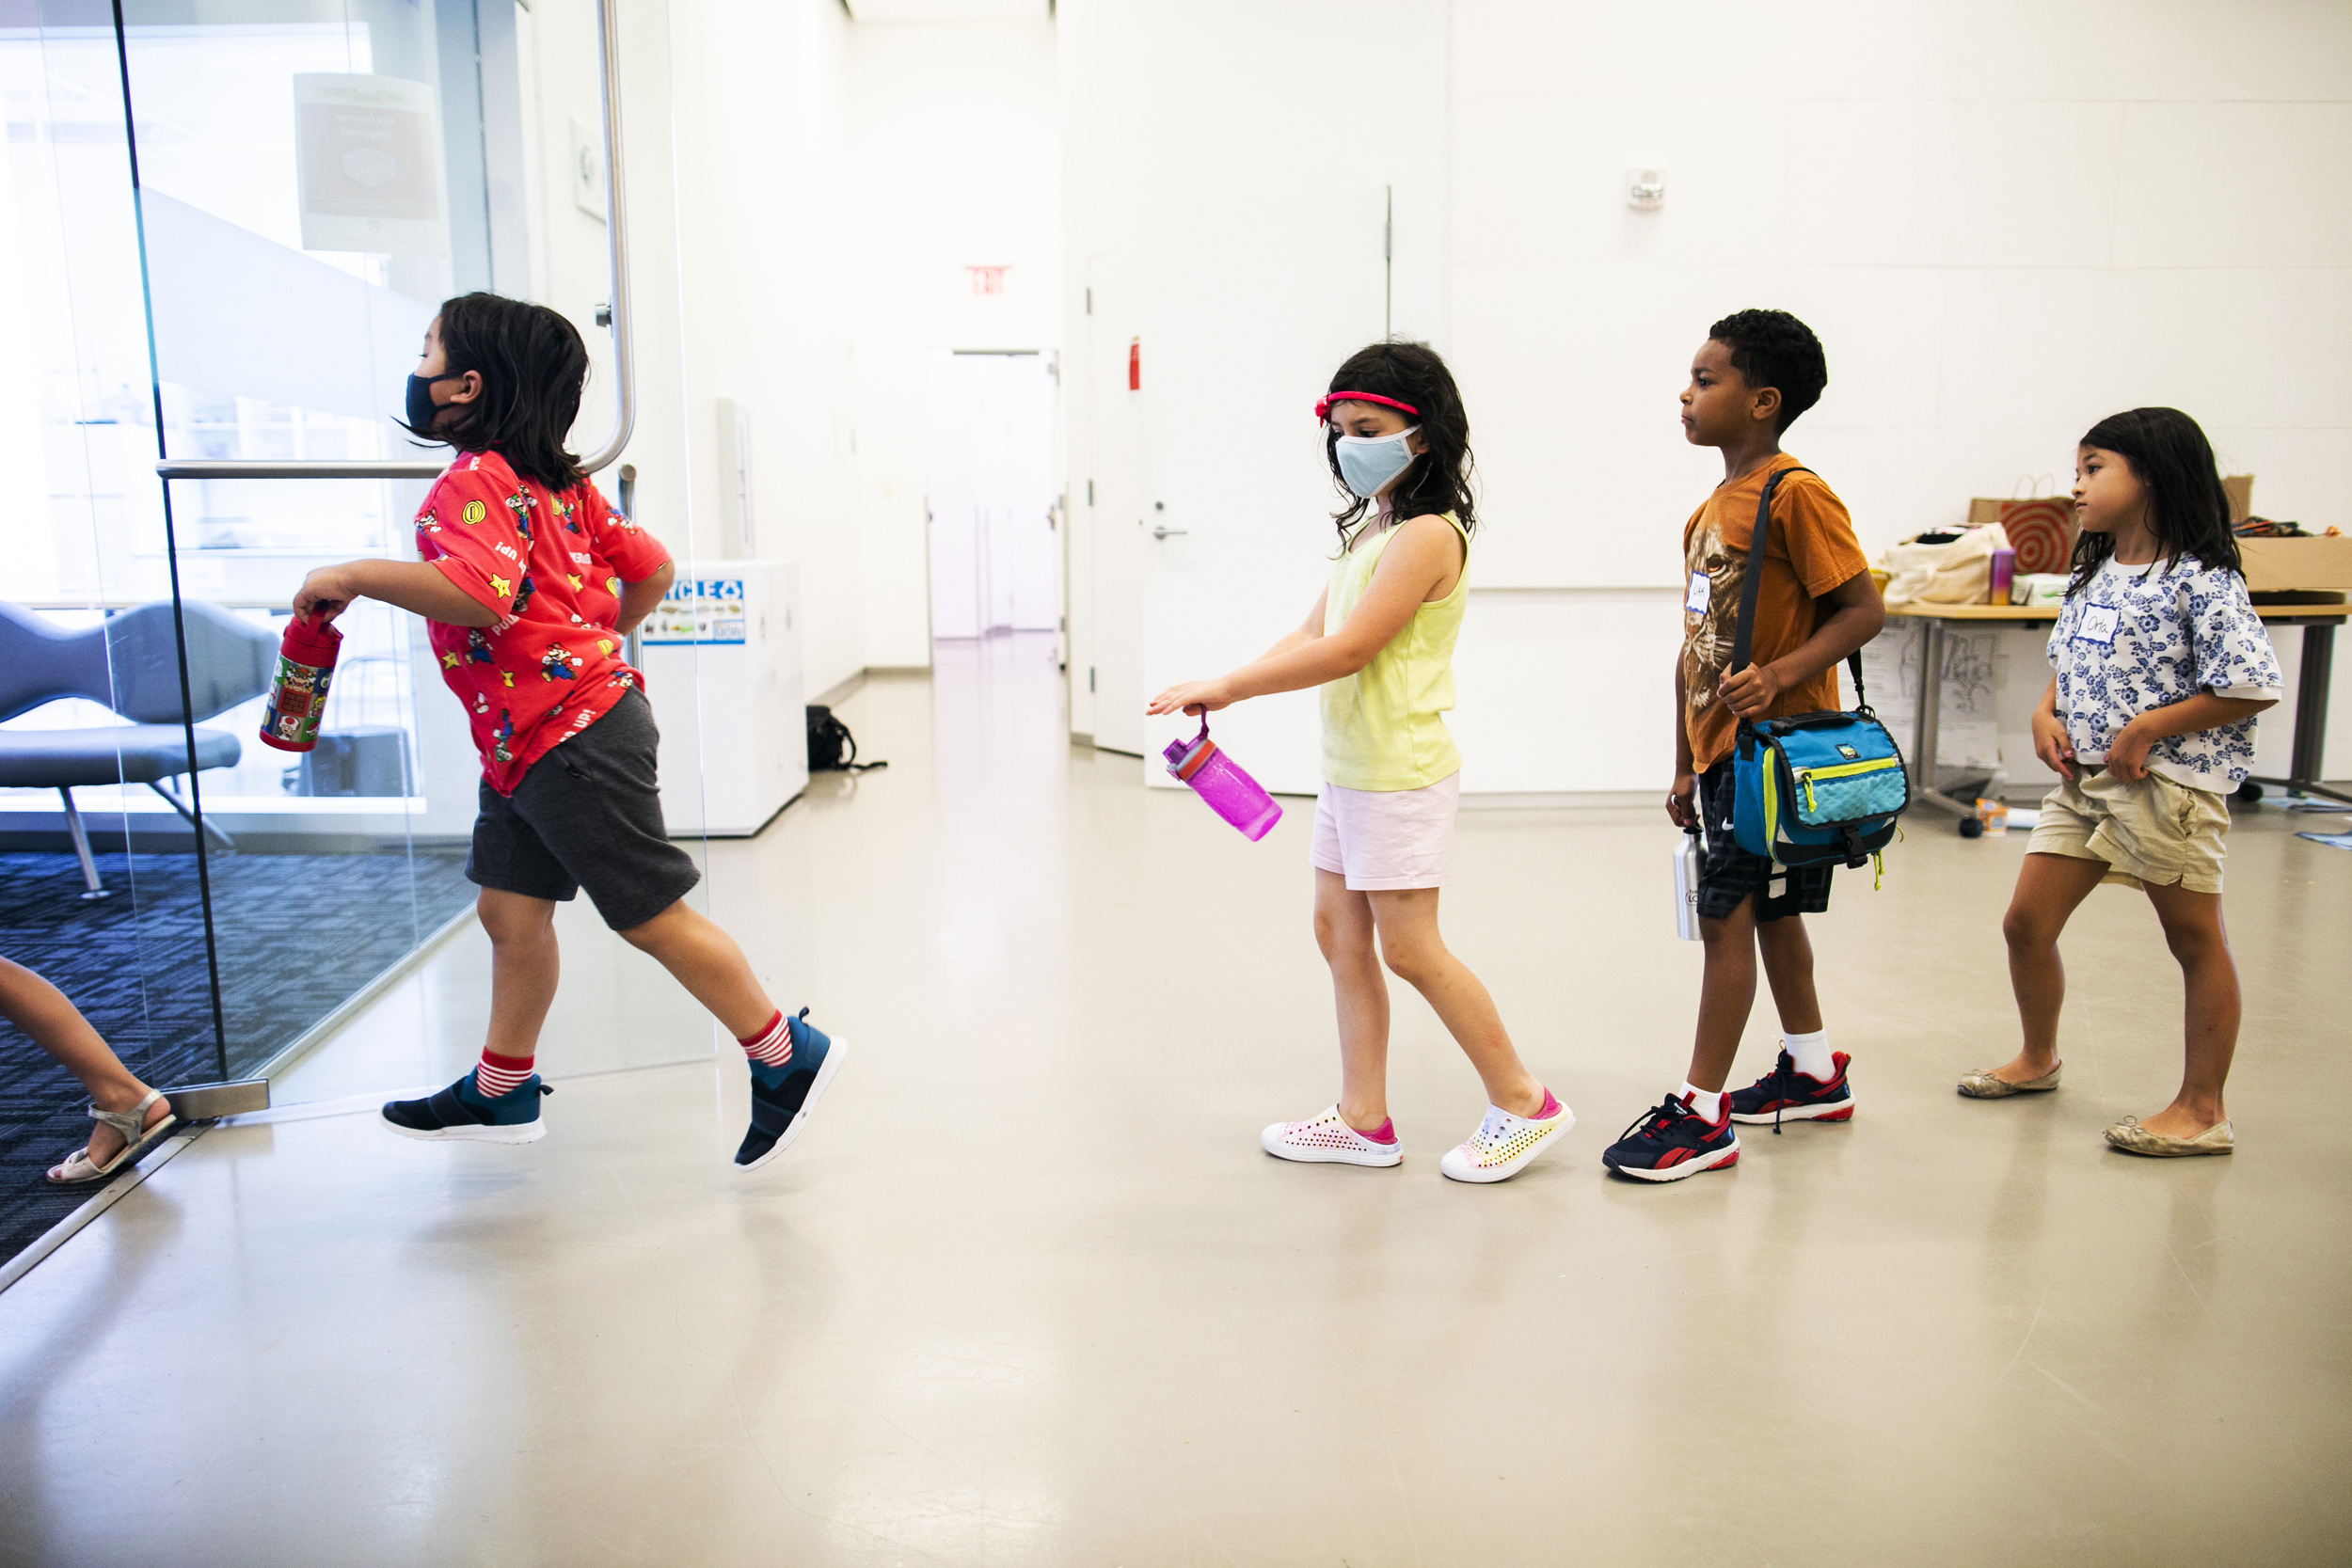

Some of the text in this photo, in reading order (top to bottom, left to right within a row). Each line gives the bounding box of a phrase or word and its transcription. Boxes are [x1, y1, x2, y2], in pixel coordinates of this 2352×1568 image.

[667, 580, 717, 600] YCLE
[572, 708, 596, 729] UP!
[1688, 895, 1699, 903] LO
